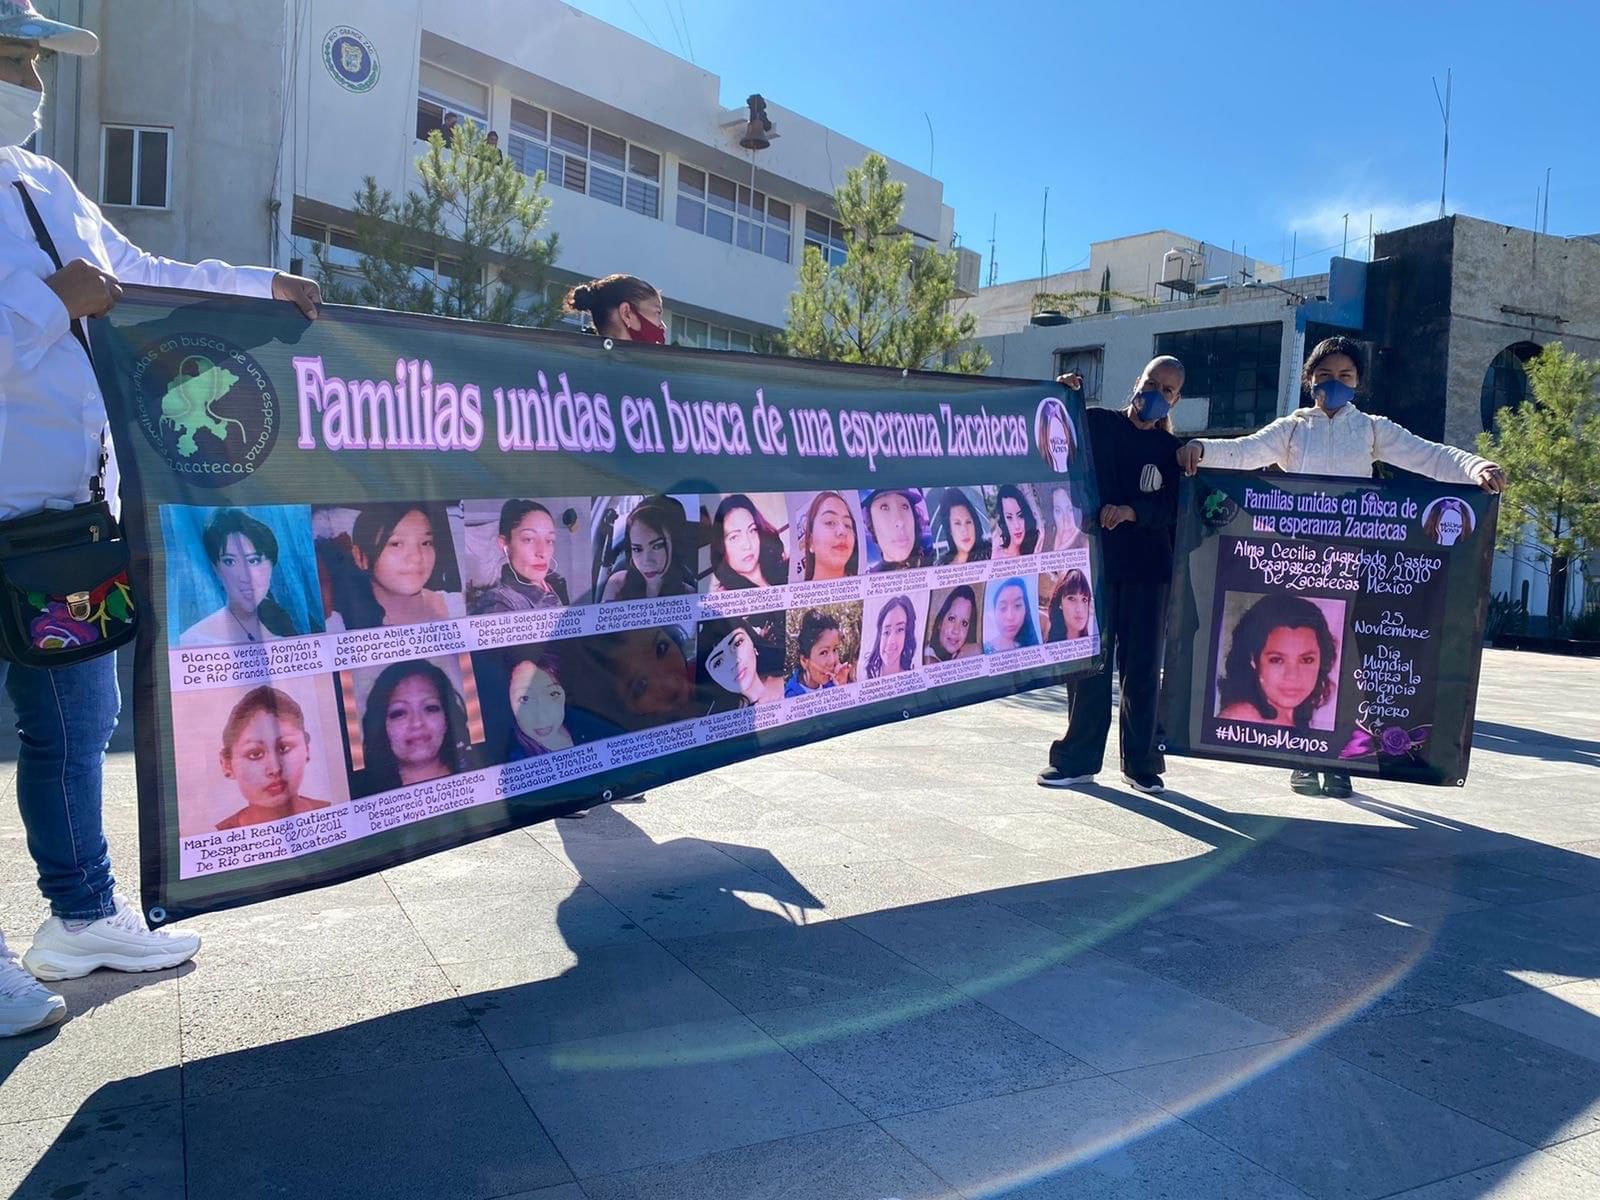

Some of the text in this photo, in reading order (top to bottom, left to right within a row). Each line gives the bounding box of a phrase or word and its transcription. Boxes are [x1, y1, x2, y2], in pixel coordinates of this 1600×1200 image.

[159, 338, 177, 352] en
[181, 336, 225, 351] busca
[229, 350, 246, 364] de
[247, 364, 266, 390] una
[292, 355, 1029, 472] Familias unidas en busca de una esperanza Zacatecas
[246, 392, 273, 460] esperanza
[1244, 488, 1294, 511] Familias
[1297, 491, 1338, 516] unidas
[1341, 499, 1357, 515] en
[1360, 494, 1397, 517] busca
[1401, 498, 1417, 519] de
[1253, 515, 1407, 541] una esperanza Zacatecas
[1234, 540, 1442, 574] Alma Cecilia Guardado Castro
[1264, 569, 1283, 584] De
[1286, 572, 1359, 591] Zacatecas
[628, 603, 653, 611] Teresa
[470, 609, 585, 628] Felipa Lili Soledad Sandoval
[598, 612, 647, 623] Desapareció
[623, 618, 650, 627] Grande
[653, 614, 692, 624] Zacatecas
[1381, 611, 1404, 625] 25
[337, 622, 458, 645] Leonela Abilet Juárez R
[478, 627, 582, 646] De Río Grande Zacatecas
[479, 623, 533, 637] Desapareció
[1355, 620, 1430, 639] Noviembre
[182, 652, 230, 662] Blanca
[271, 641, 310, 654] Román
[314, 640, 321, 648] R
[335, 641, 465, 666] De Río Grande Zacatecas
[337, 638, 405, 655] Desapareció
[1377, 645, 1400, 660] Día
[188, 658, 260, 673] Desapareció
[1363, 654, 1413, 672] Mundial
[184, 675, 201, 684] De
[207, 672, 227, 682] Río
[232, 669, 264, 680] Grande
[1354, 665, 1421, 684] contra la
[1357, 680, 1416, 695] violencia
[1377, 691, 1396, 704] de
[713, 714, 731, 722] Laura
[1358, 700, 1409, 723] Género
[607, 738, 634, 749] Alondra
[635, 730, 668, 741] Viridiana
[612, 740, 654, 756] Desapareció
[1216, 725, 1328, 752] #NiUnaMenos
[634, 748, 658, 759] Grande
[661, 738, 696, 752] Zacatecas
[500, 765, 521, 777] Alma
[524, 759, 549, 770] Lucila
[552, 750, 585, 762] Ramírez
[498, 766, 552, 786] Desapareció
[510, 774, 557, 792] Guadalupe
[559, 762, 603, 778] Zacatecas
[354, 774, 485, 814] Deisy Paloma Cruz Castañeda
[369, 799, 423, 820] Desapareció
[370, 796, 475, 831] De Luis Moya Zacatecas
[184, 807, 349, 850] Maria del Refugio Gutierrez
[201, 838, 282, 860] Desaparecio
[197, 862, 213, 872] De
[219, 857, 239, 869] Rio
[243, 846, 287, 863] Grande
